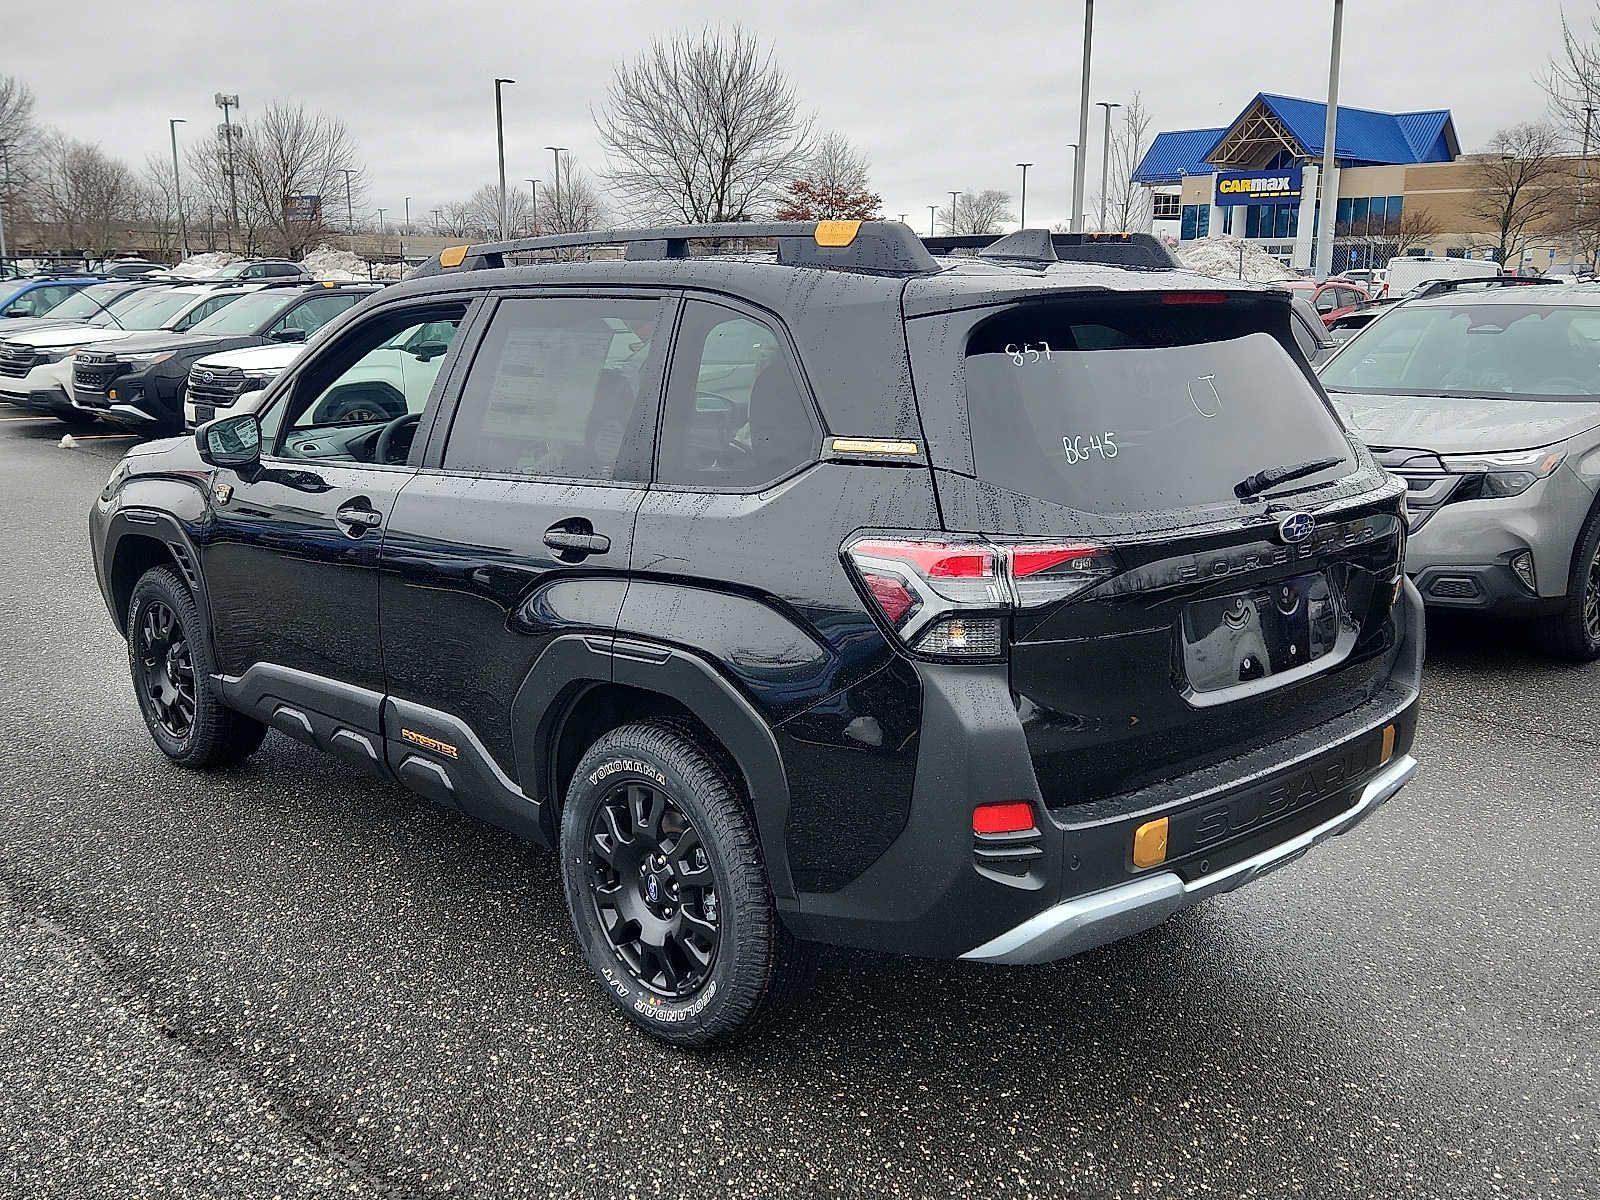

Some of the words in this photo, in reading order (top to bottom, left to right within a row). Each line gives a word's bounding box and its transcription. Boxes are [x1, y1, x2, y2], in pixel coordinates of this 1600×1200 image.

[1005, 341, 1050, 366] 857
[1062, 431, 1118, 464] BG45
[401, 728, 458, 758] FORESTER
[589, 760, 665, 785] YOKOHAMA
[1196, 758, 1367, 844] SUBARU
[601, 967, 629, 997] A/T
[634, 980, 717, 1021] GEOLANDAR
